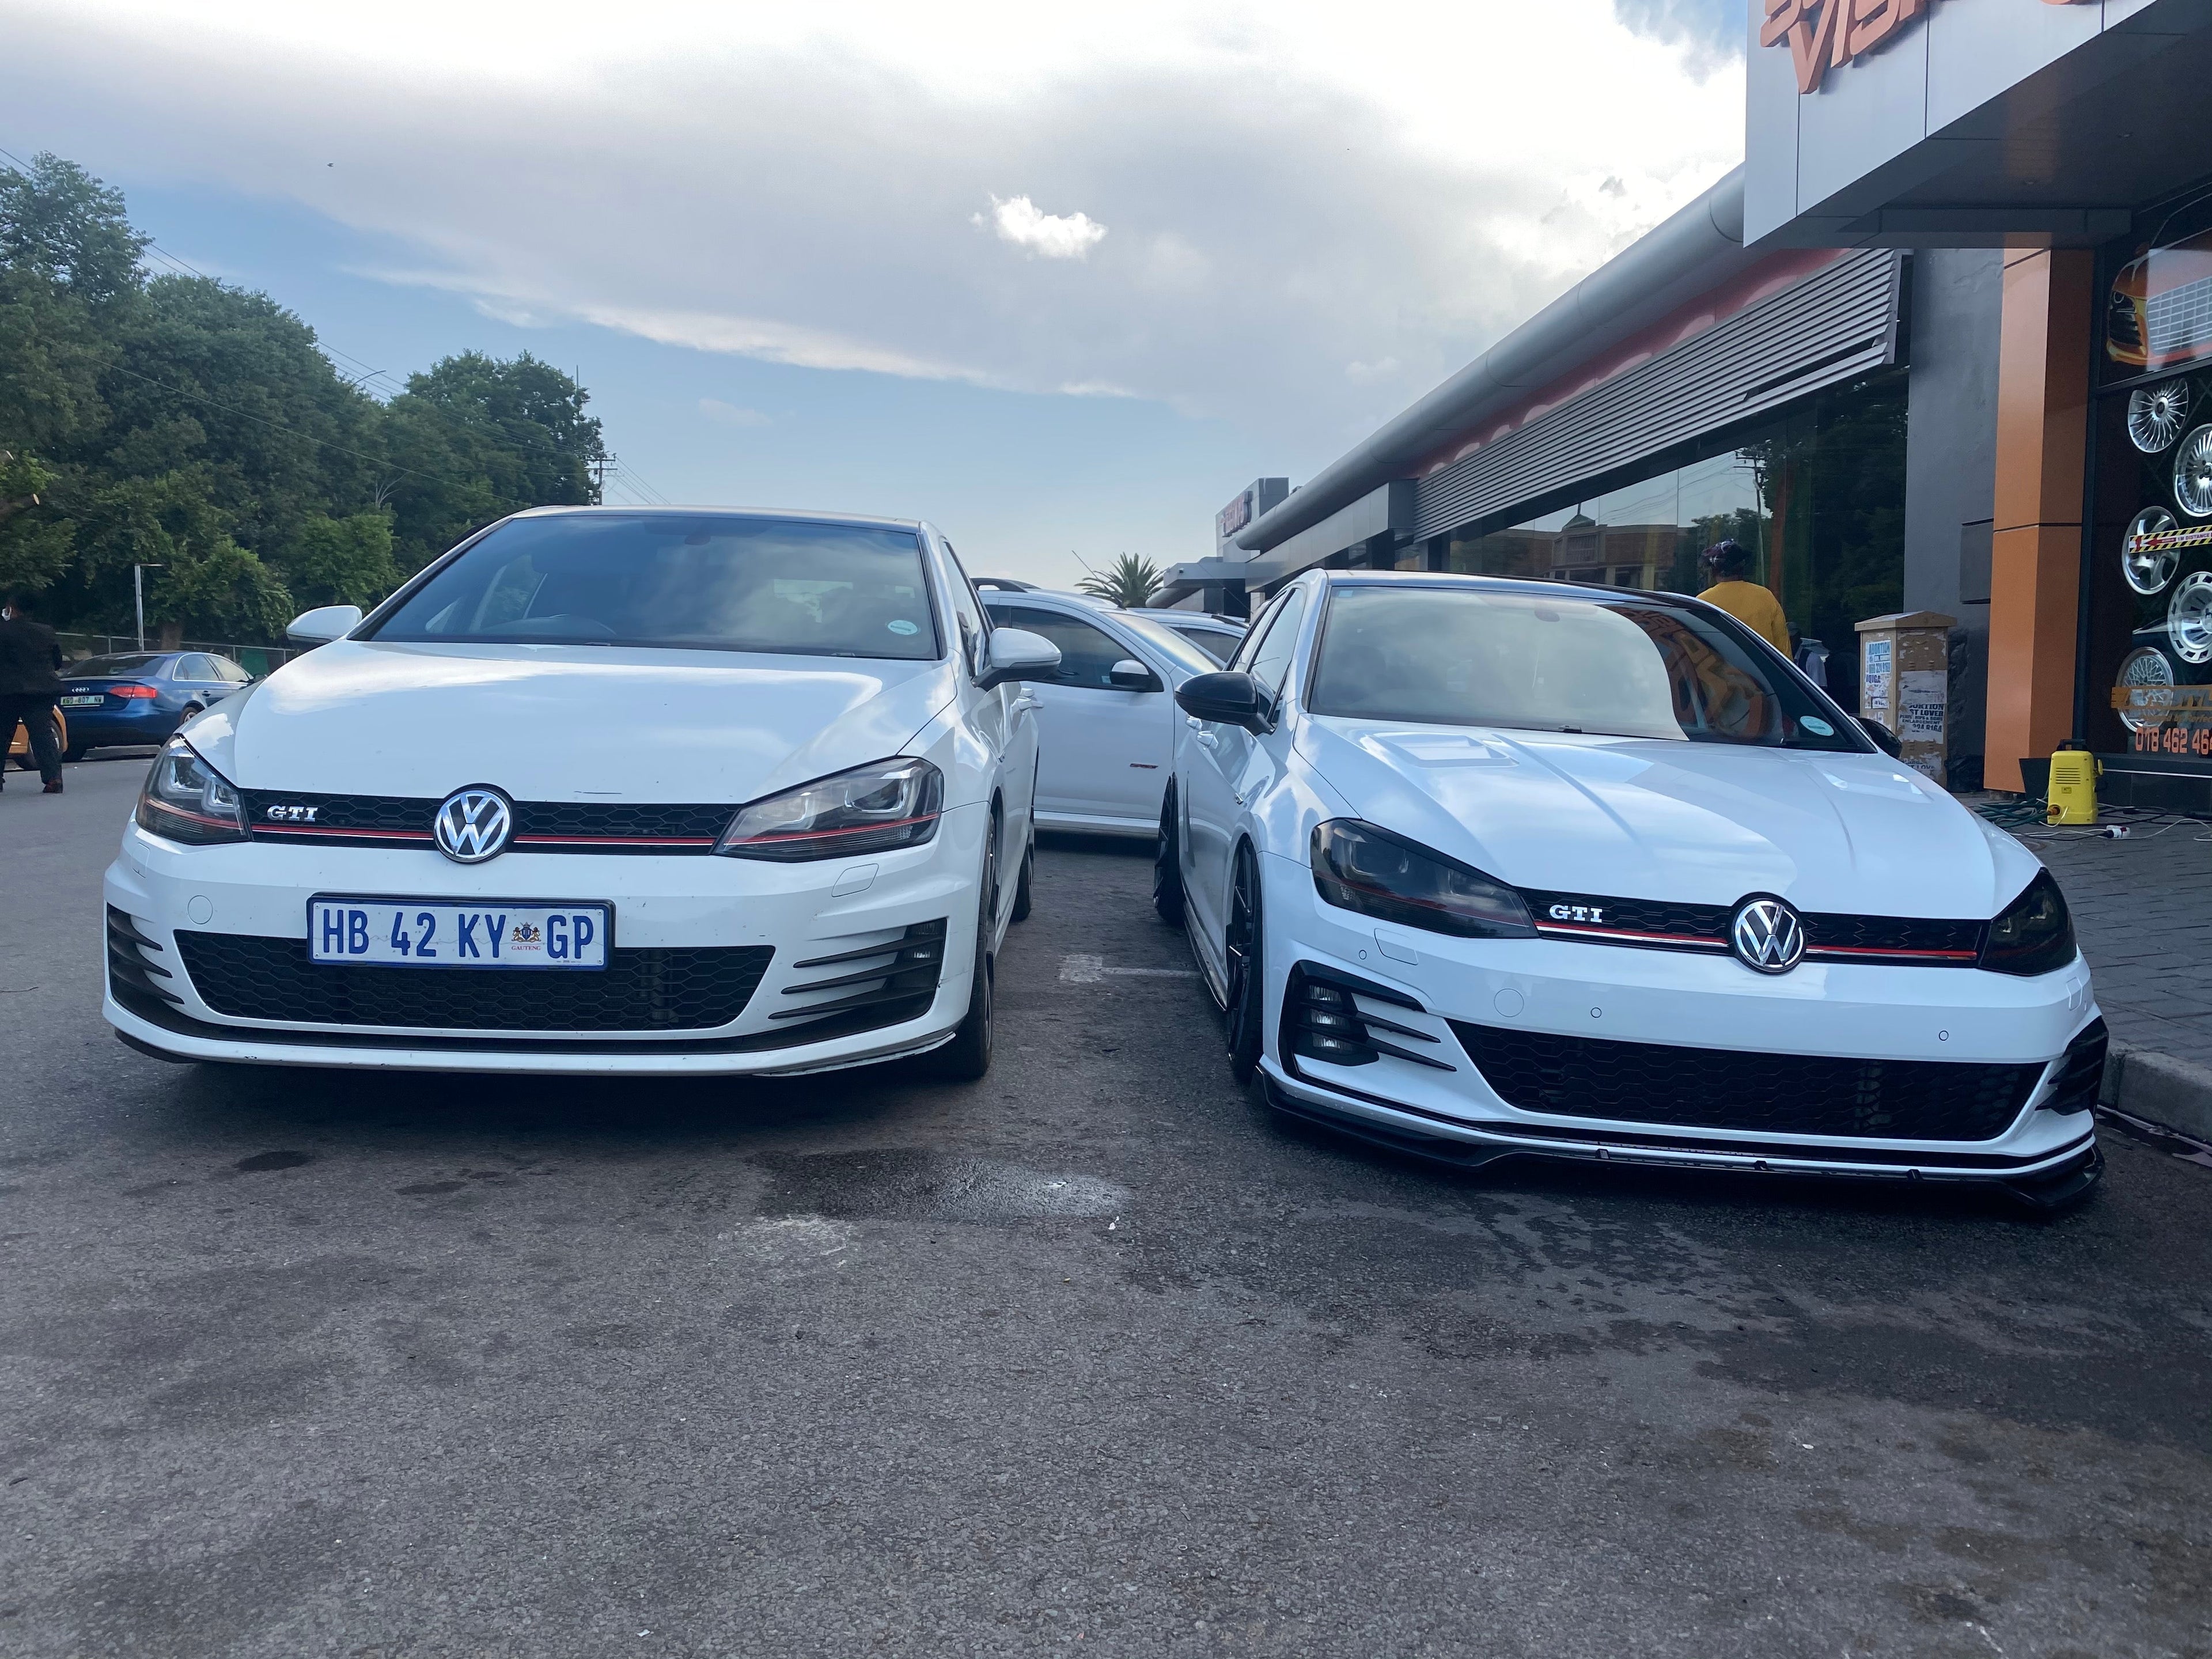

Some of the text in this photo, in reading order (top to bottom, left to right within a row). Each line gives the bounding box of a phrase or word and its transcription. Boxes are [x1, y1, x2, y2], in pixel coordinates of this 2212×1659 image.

[2136, 726, 2160, 752] 018
[2164, 728, 2188, 753] 462
[267, 805, 319, 822] GTI
[1549, 904, 1603, 923] GTI
[323, 909, 594, 959] HB 42 KY GP
